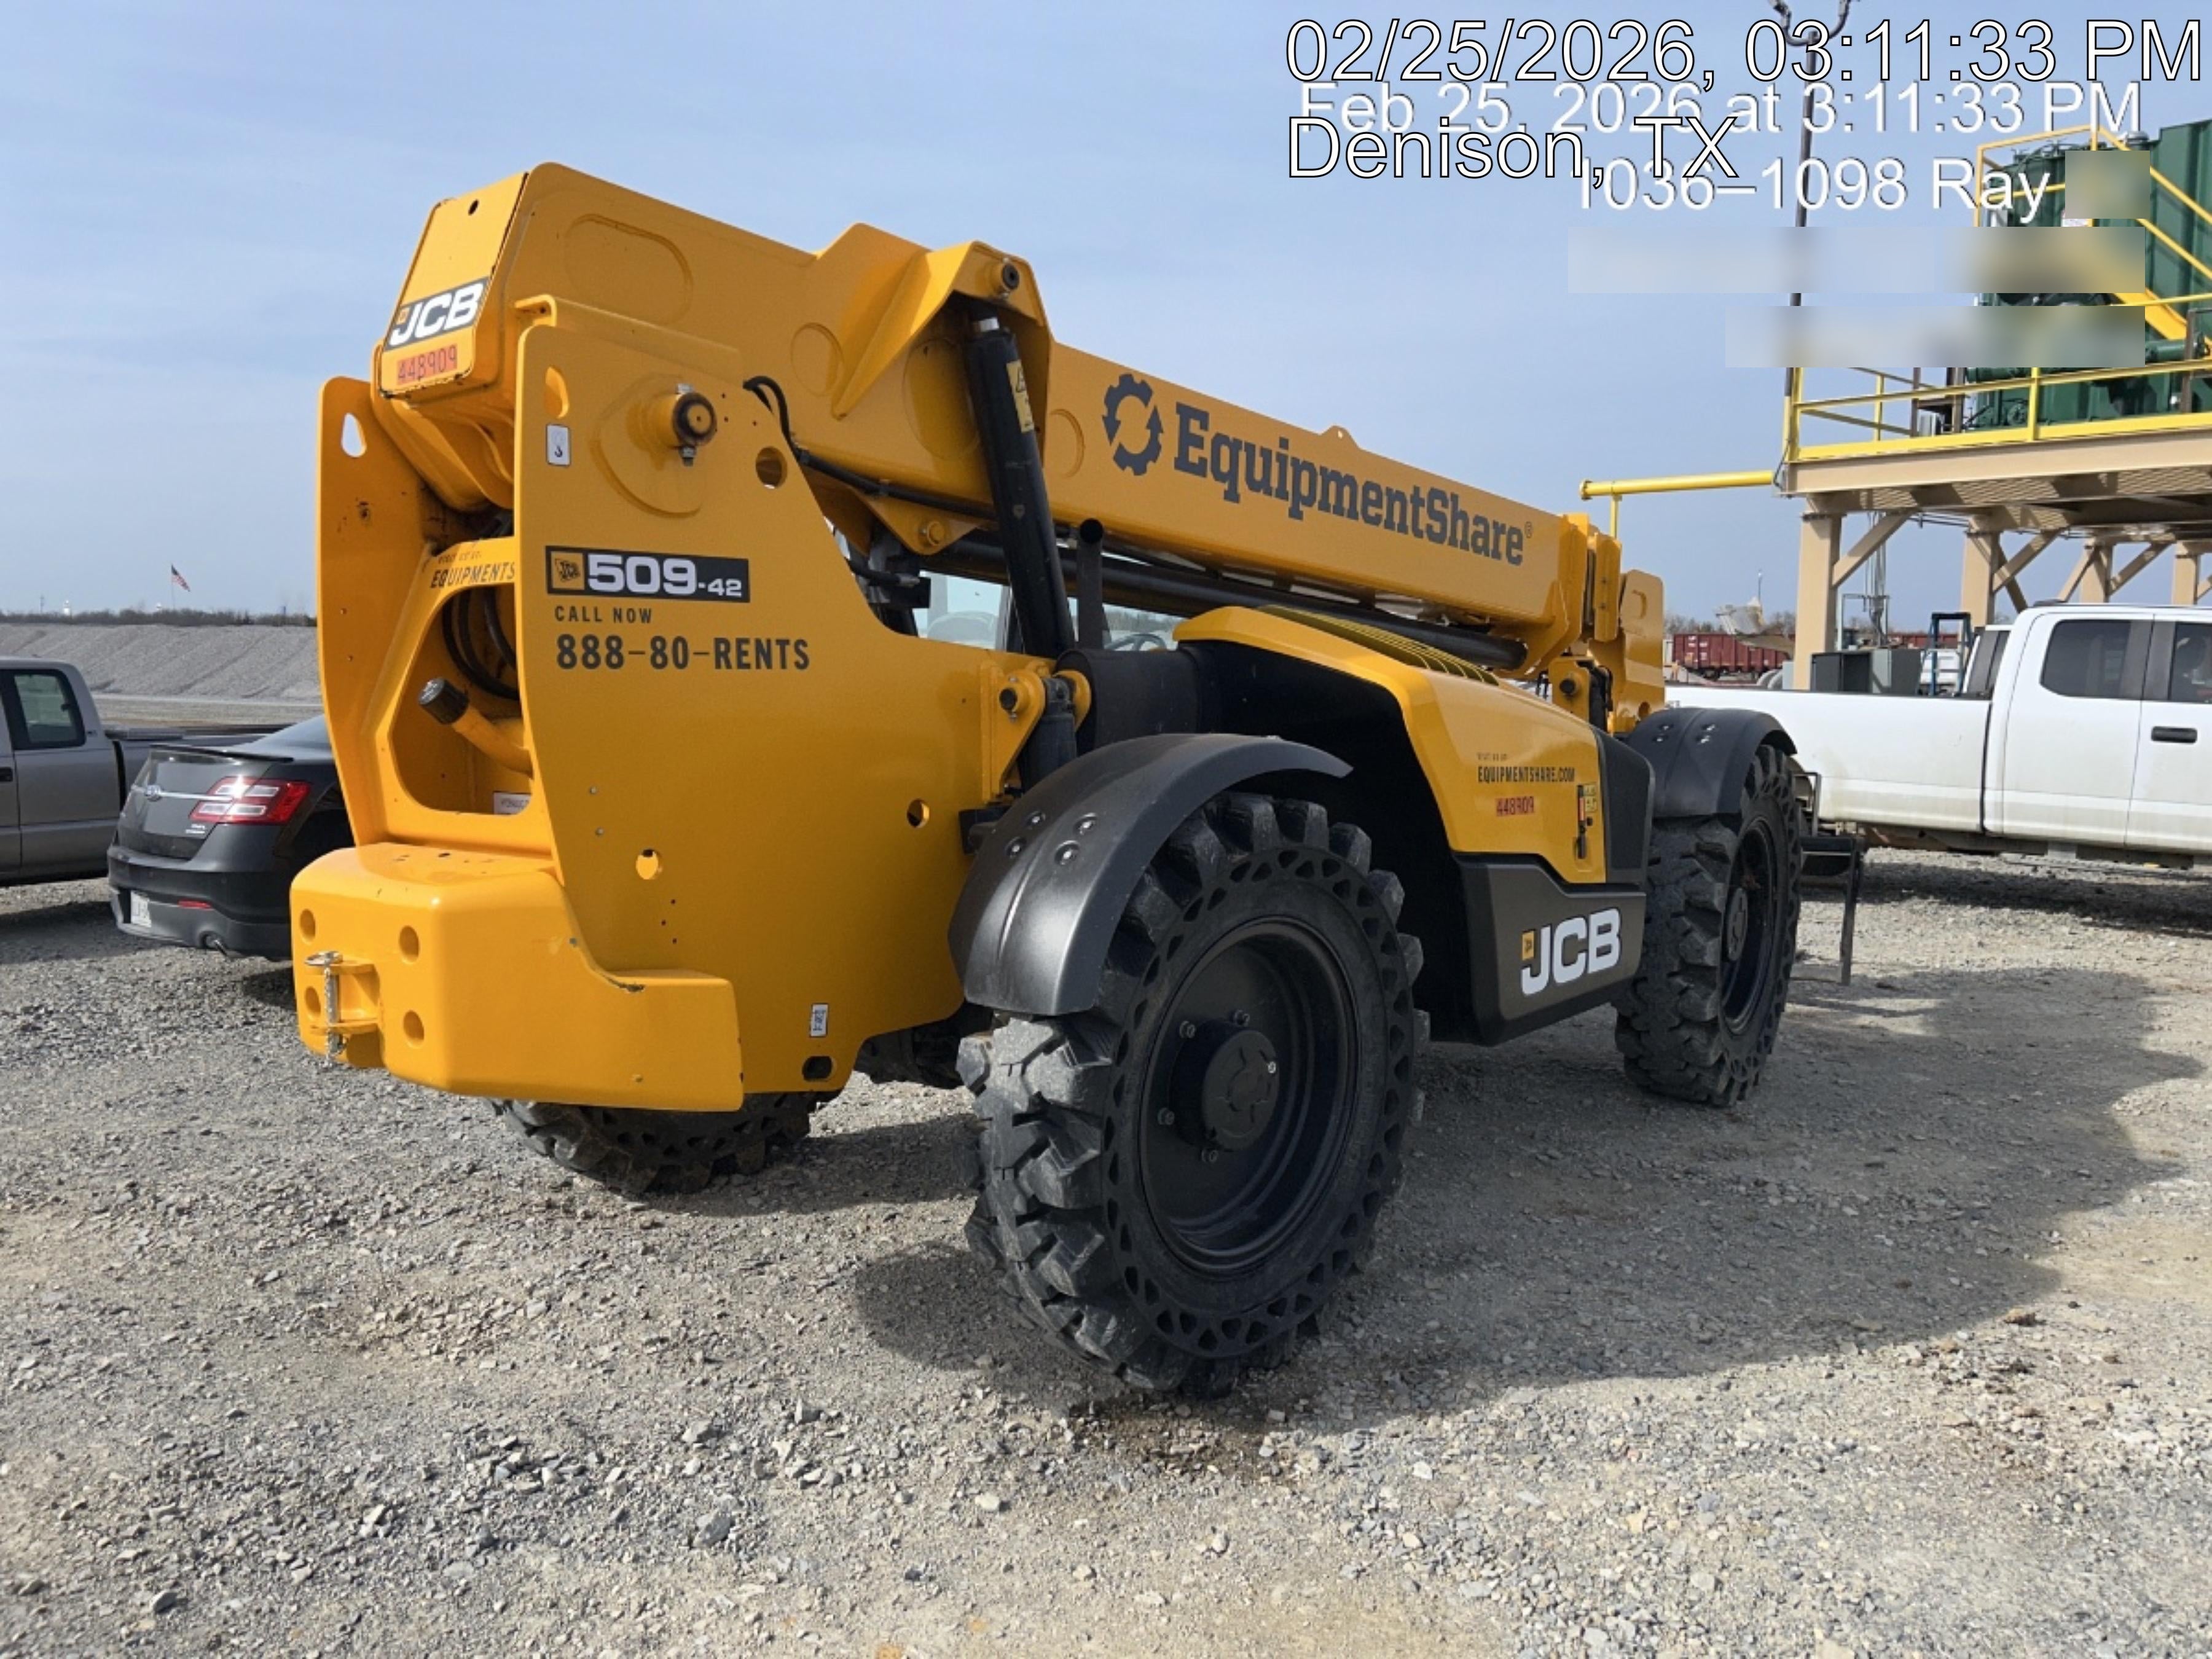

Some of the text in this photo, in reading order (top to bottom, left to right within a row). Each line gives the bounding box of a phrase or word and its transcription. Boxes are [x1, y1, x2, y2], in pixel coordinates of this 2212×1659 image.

[389, 283, 484, 347] JCB
[398, 345, 457, 381] 448909
[554, 605, 653, 624] CALL NOW
[557, 633, 810, 670] 888-80-RENTS
[1478, 766, 1575, 783] EQUIPMENTSHARE.COM
[1521, 908, 1621, 996] JCB
